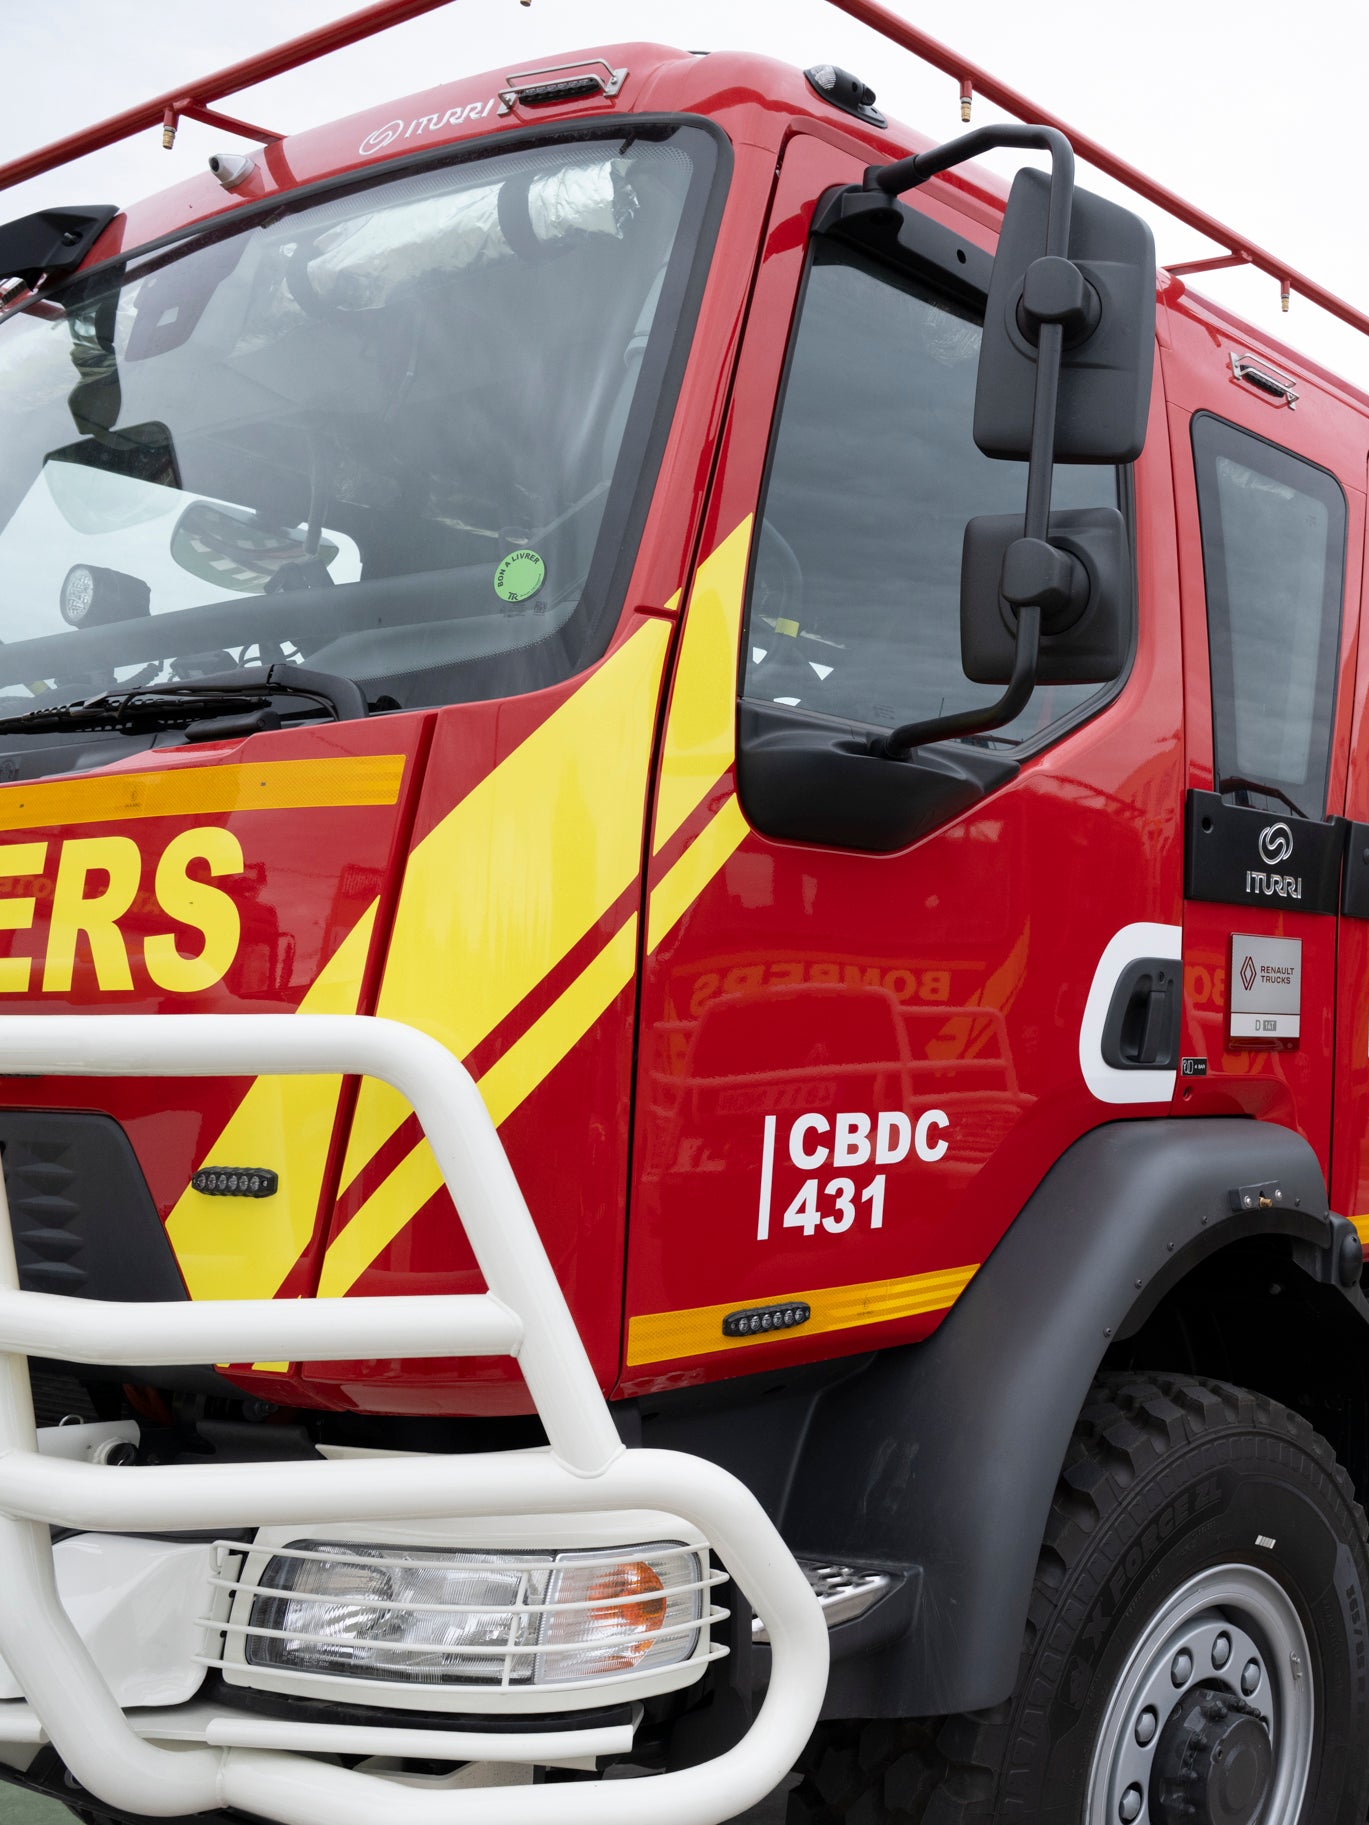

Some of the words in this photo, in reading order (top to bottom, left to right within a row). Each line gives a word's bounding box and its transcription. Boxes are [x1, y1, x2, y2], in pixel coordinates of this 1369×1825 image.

[404, 98, 495, 138] ITURRI
[497, 568, 506, 587] BON
[511, 552, 540, 564] LIVRER
[1246, 870, 1302, 899] ITURRI
[1260, 965, 1295, 976] RENAULT
[1260, 975, 1291, 985] TRUCKS
[789, 1109, 950, 1170] CBDC
[783, 1174, 886, 1236] 431
